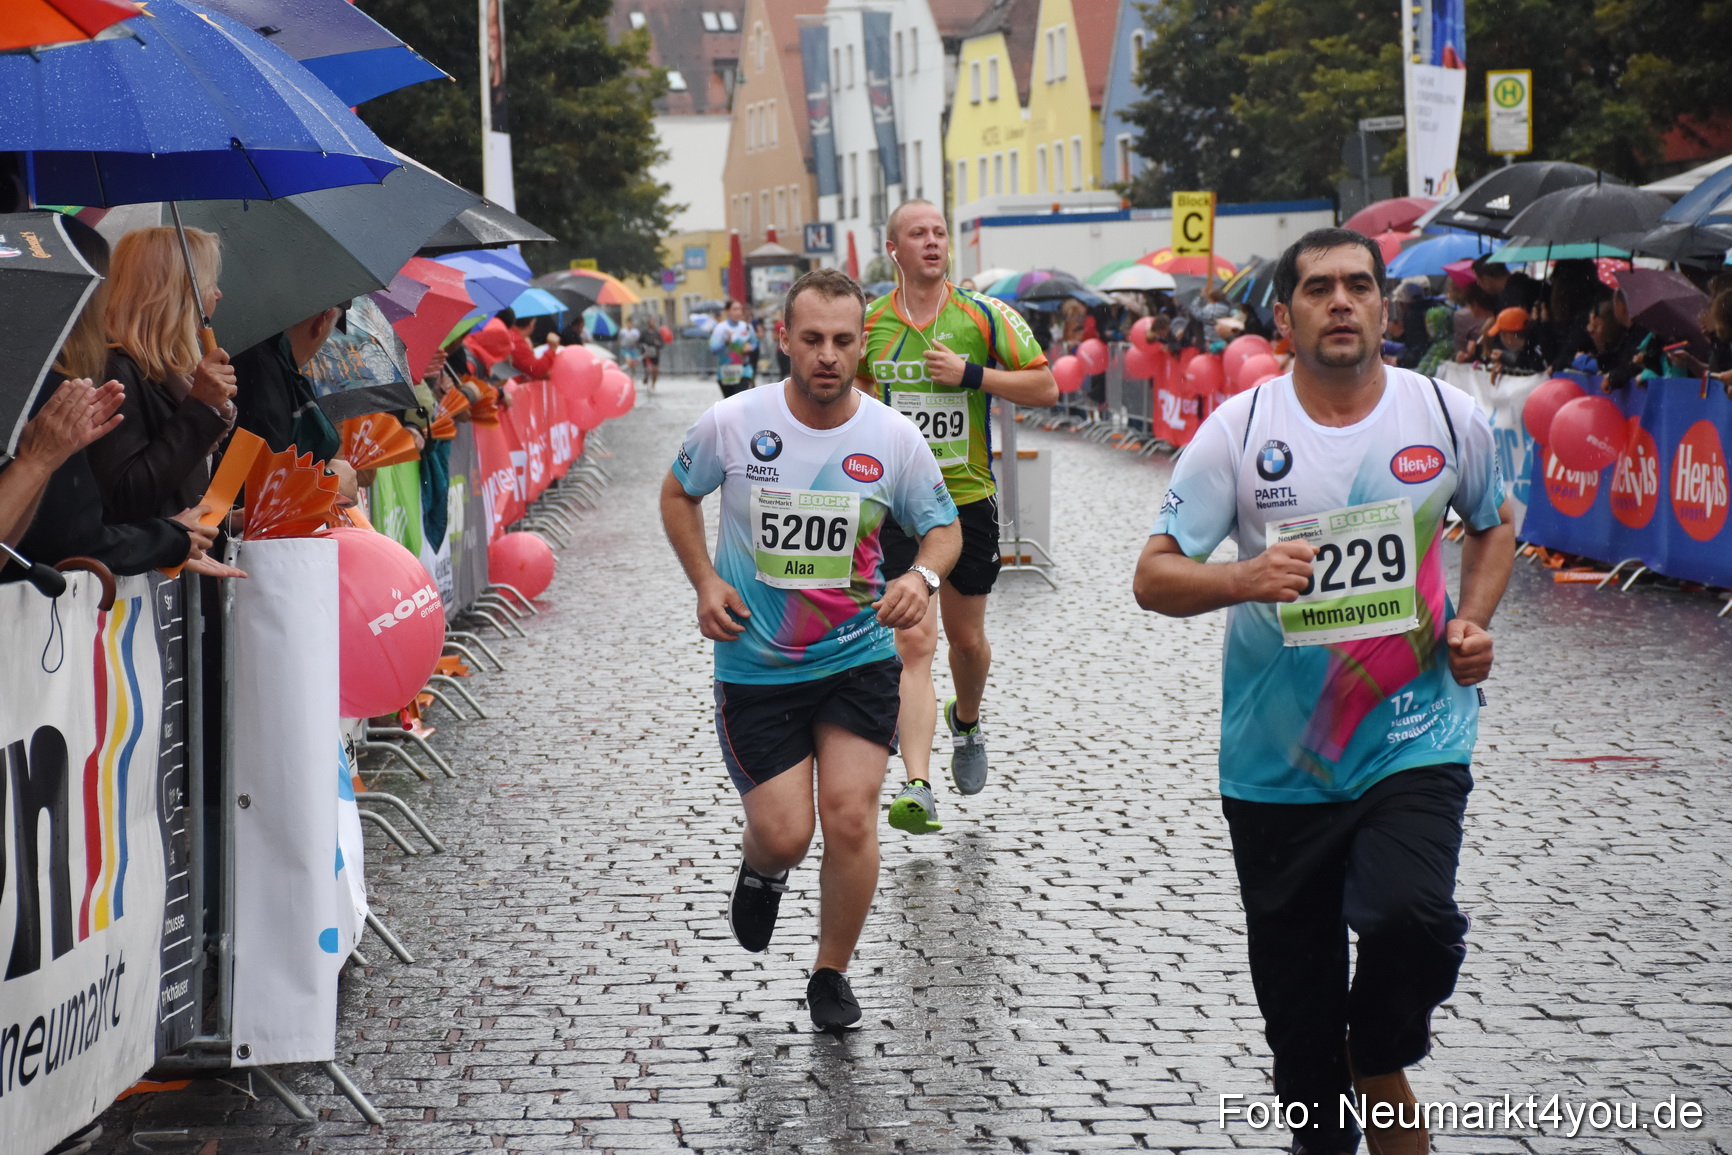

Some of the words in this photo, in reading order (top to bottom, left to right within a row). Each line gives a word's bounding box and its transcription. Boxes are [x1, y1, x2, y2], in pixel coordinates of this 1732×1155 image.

[1178, 195, 1211, 207] Block
[1182, 212, 1204, 242] C
[926, 395, 965, 405] BOCK
[900, 410, 964, 439] 269
[746, 464, 780, 477] PARTL
[848, 458, 879, 476] Hervis
[1398, 454, 1440, 474] Hervis
[745, 472, 779, 483] Neumarkt
[1675, 443, 1727, 518] Hervis
[758, 498, 793, 507] NeuerMarkt
[799, 494, 850, 508] BOCK
[1255, 487, 1297, 501] PARTL
[1256, 499, 1298, 510] Neumarkt
[1329, 504, 1401, 531] BOCK
[761, 512, 848, 552] 5206
[1278, 529, 1323, 543] NeuerMarkt
[784, 561, 815, 575] Alaa
[368, 584, 438, 636] RÖDL
[1302, 600, 1401, 626] Homayoon
[1391, 691, 1419, 716] 17.
[0, 950, 125, 1098] neumarkt
